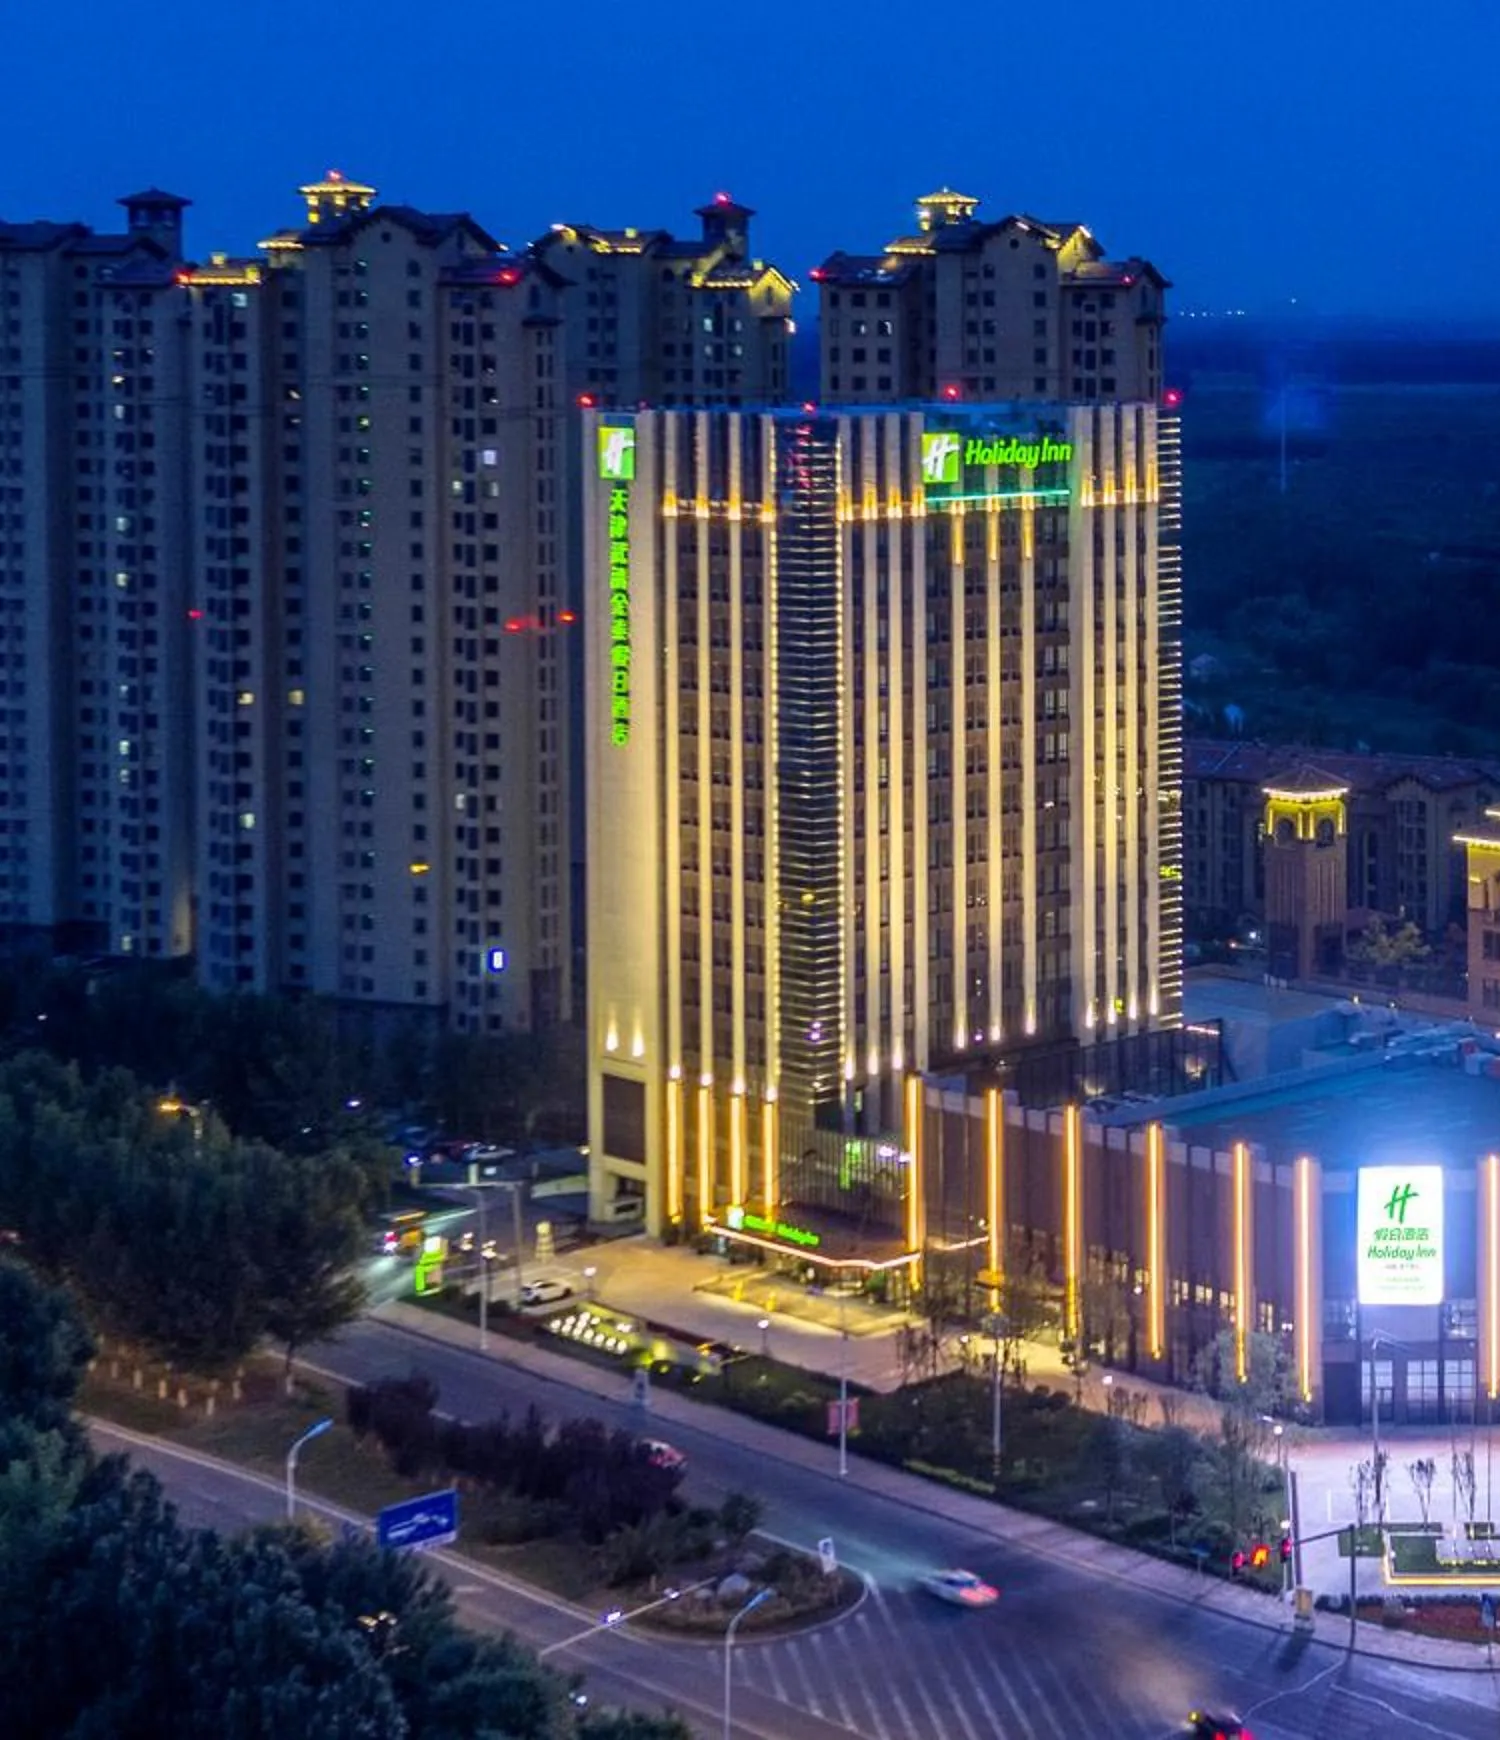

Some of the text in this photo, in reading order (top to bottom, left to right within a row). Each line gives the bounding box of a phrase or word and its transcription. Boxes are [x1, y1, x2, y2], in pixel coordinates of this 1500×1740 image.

[965, 436, 1073, 469] Holiday Inn
[1367, 1243, 1437, 1261] Holiday Inn
